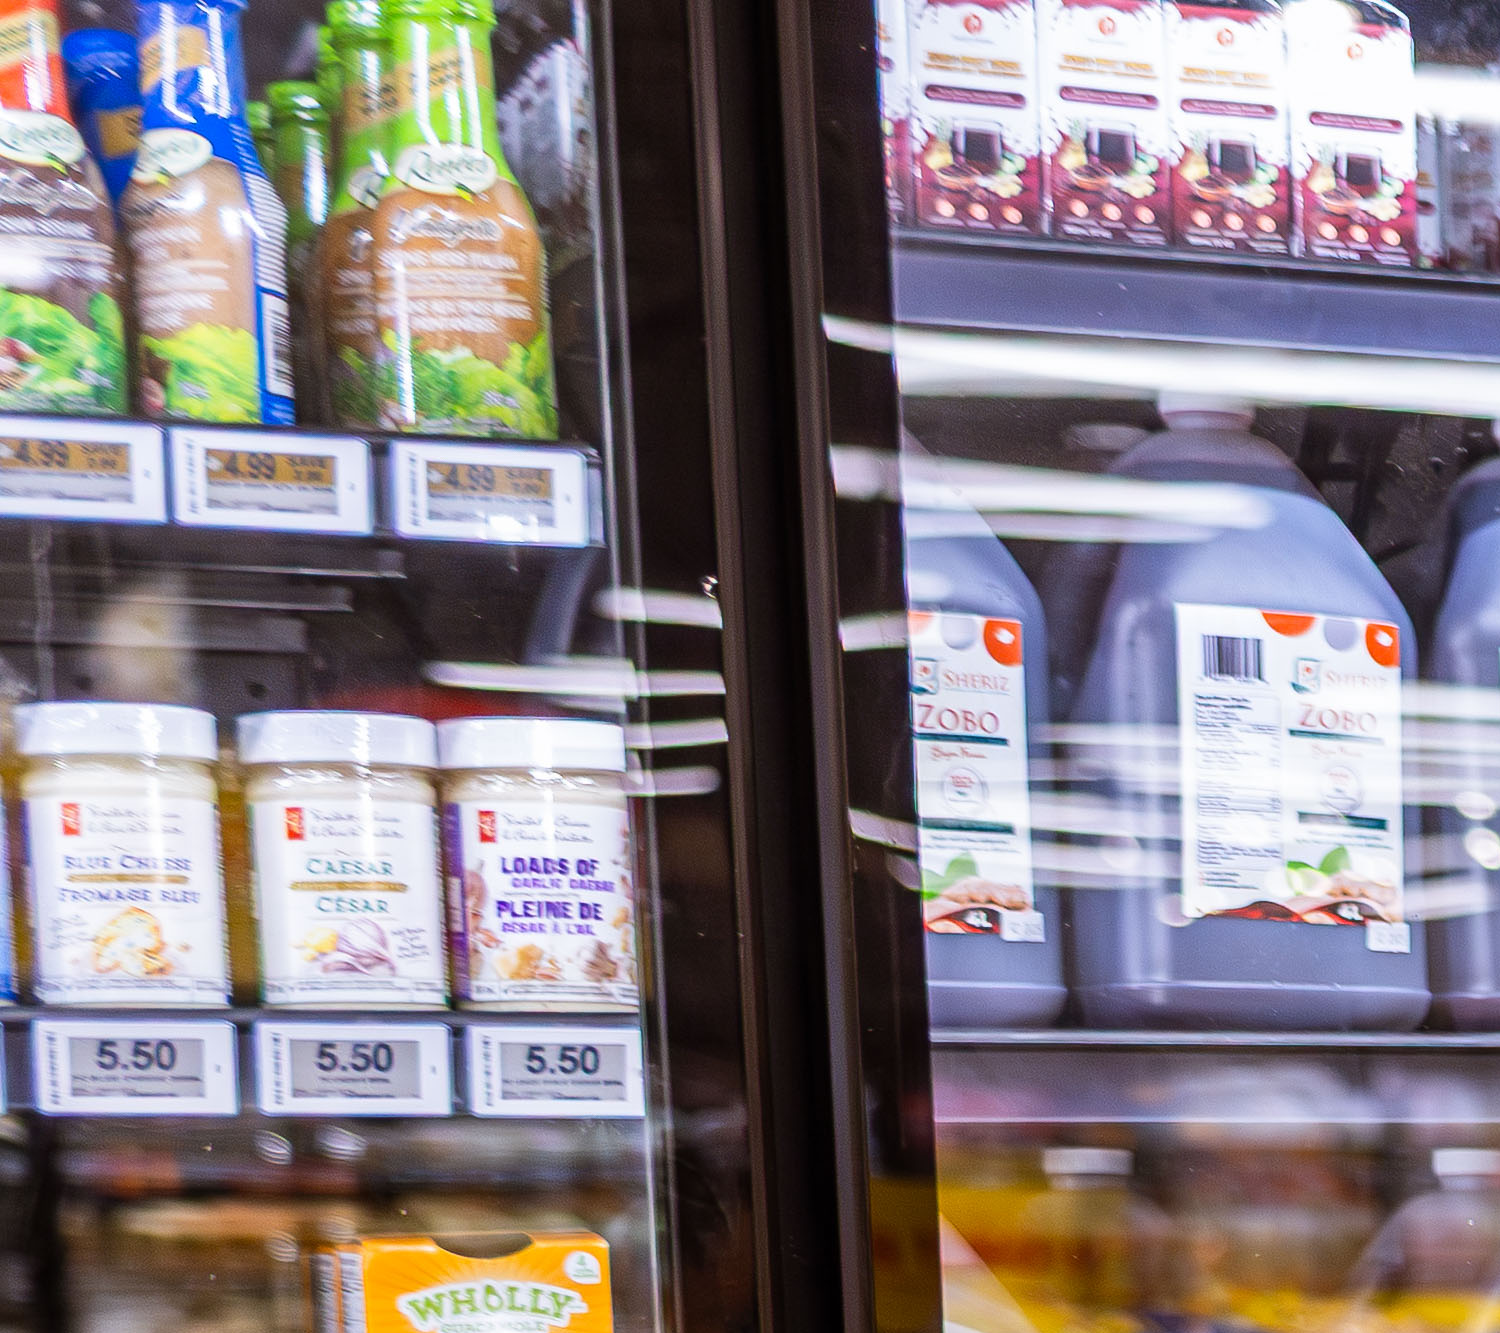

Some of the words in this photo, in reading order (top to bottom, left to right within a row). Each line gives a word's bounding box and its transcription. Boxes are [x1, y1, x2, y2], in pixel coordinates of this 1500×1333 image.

[223, 450, 276, 482] 4.99
[444, 460, 496, 493] 4.99
[942, 668, 1010, 693] SHERIZ
[917, 704, 1000, 734] ZOBO
[1300, 704, 1377, 733] ZOBO
[306, 858, 394, 876] CAESAR
[501, 856, 570, 876] LOADS
[576, 858, 600, 876] OF
[496, 900, 574, 920] PLEINE
[578, 902, 603, 921] DE
[95, 1039, 177, 1073] 5.50
[316, 1042, 394, 1074] 5.50
[523, 1044, 601, 1076] 5.50
[408, 1283, 576, 1322] WHOLLY
